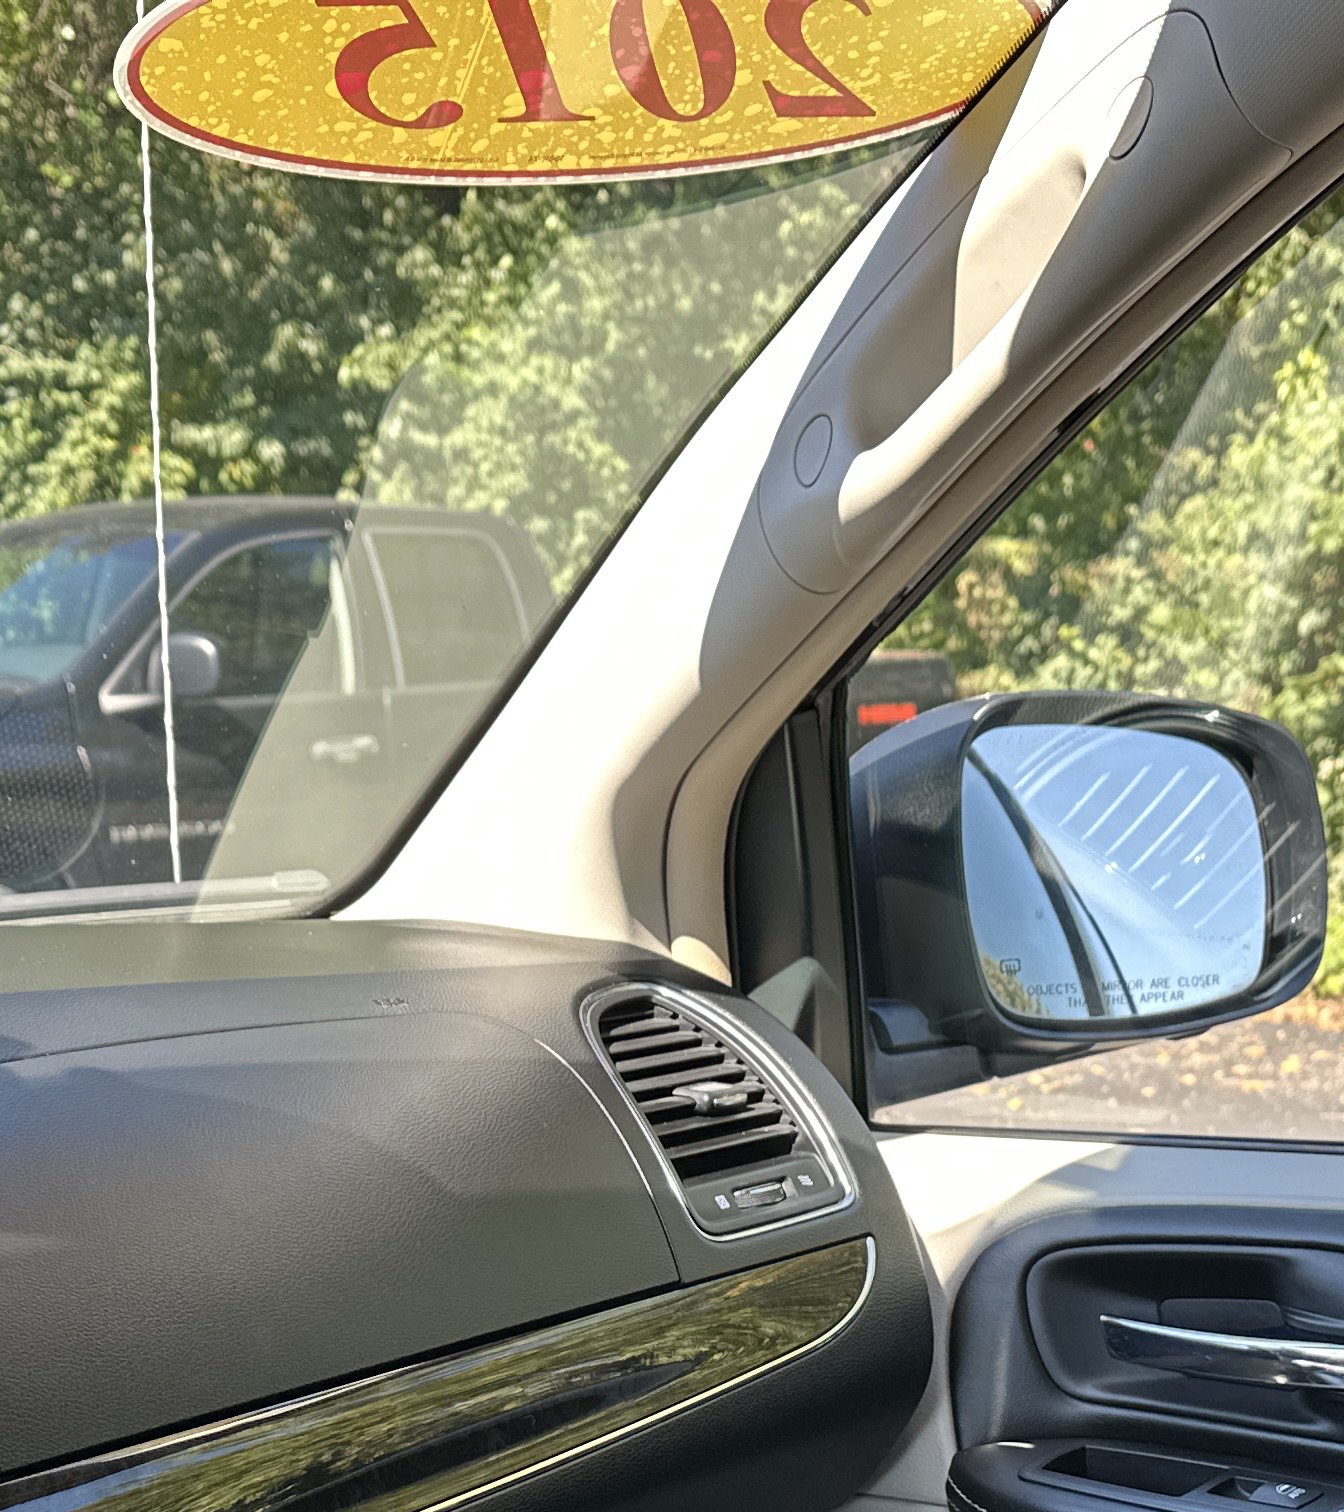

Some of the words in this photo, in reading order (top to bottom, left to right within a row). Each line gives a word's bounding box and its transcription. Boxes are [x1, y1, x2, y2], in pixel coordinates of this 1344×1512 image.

[1027, 982, 1077, 996] OBJECTS
[1102, 979, 1143, 992] MIROR
[1150, 977, 1171, 989] ARE
[1178, 974, 1221, 988] CLOSER
[1139, 990, 1184, 1003] APPEAR
